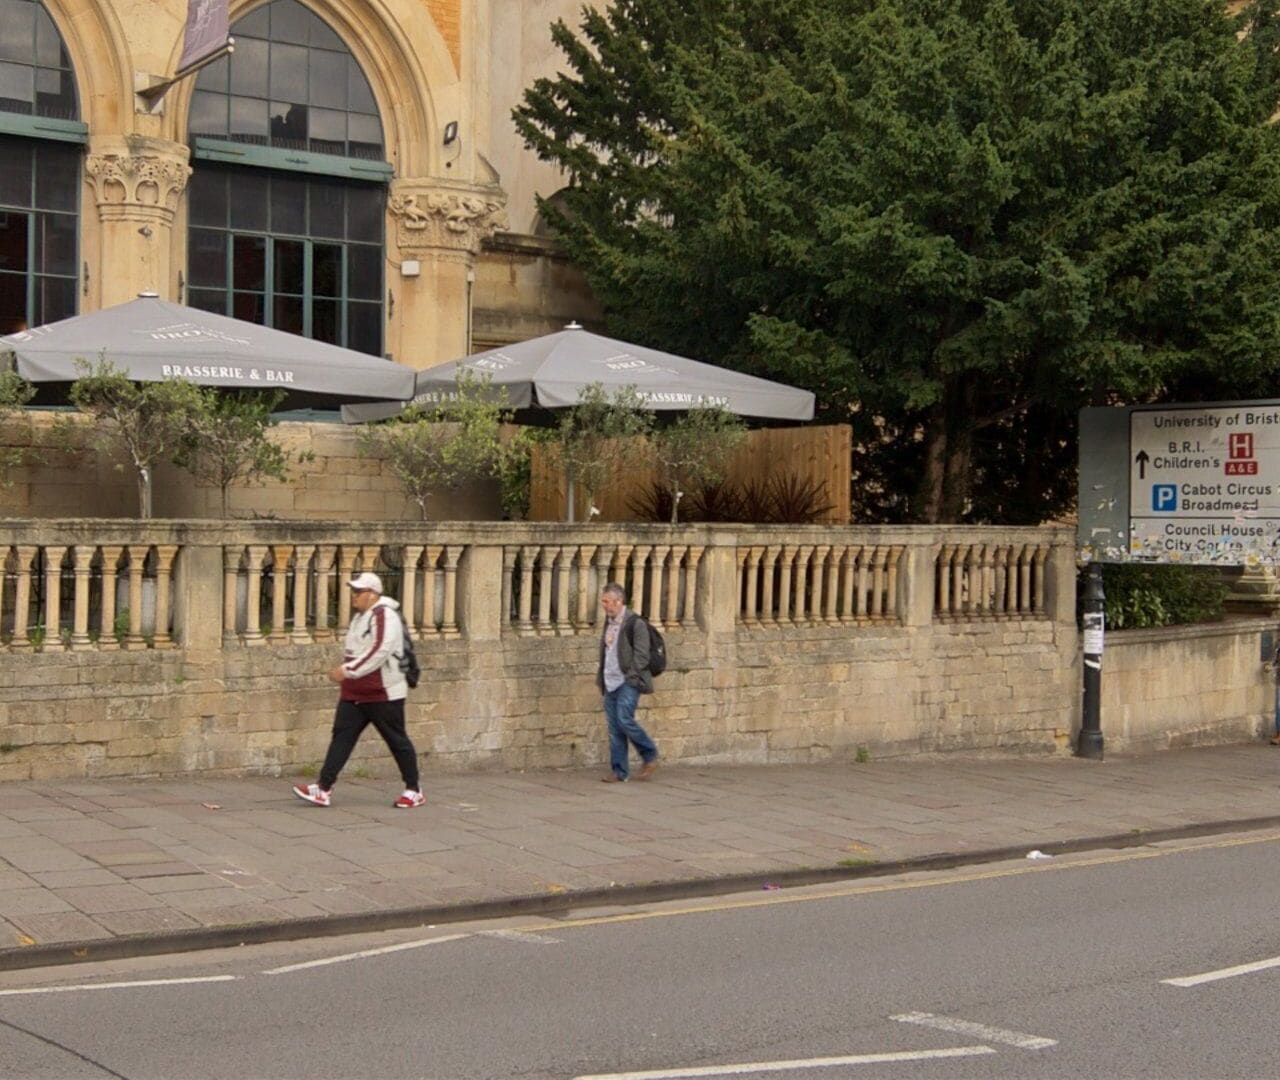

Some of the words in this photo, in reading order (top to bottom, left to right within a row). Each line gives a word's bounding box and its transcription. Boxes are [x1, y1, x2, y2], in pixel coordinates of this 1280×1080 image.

[162, 365, 244, 380] BRASSERIE
[250, 369, 260, 380] &
[266, 370, 294, 382] BAR
[1154, 415, 1221, 429] University
[1226, 414, 1240, 426] of
[1153, 456, 1220, 470] Children's
[1228, 463, 1255, 474] A&E
[1158, 487, 1173, 509] P
[1181, 483, 1222, 496] Cabot
[1227, 483, 1272, 496] Circus
[1181, 498, 1258, 511] Broadmead
[1165, 523, 1216, 536] Council
[1222, 524, 1264, 537] House
[1165, 538, 1191, 552] City
